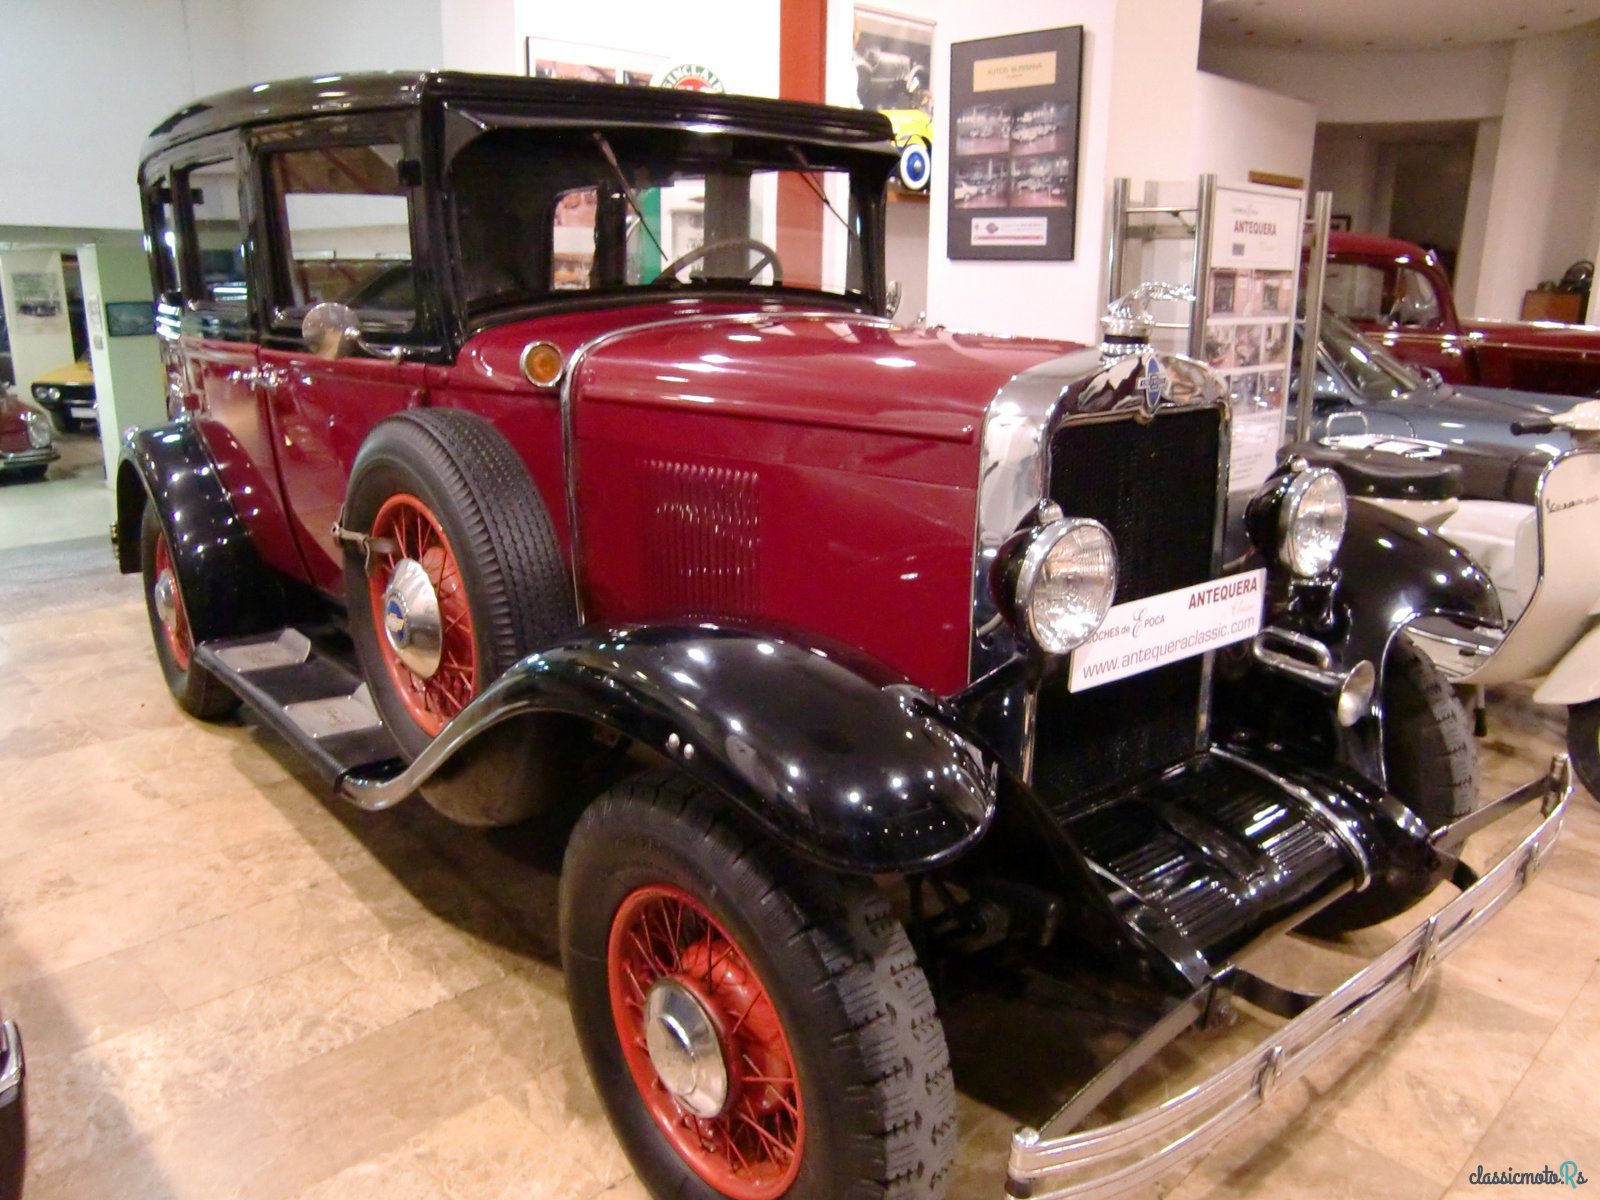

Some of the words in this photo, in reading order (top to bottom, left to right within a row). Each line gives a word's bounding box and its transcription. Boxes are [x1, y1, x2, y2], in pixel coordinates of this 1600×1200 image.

[1233, 219, 1277, 236] ANTEQUERA
[1188, 577, 1257, 610] ANTEQUERA
[1121, 624, 1131, 634] de
[1083, 616, 1255, 679] www.antequeraclassic.com
